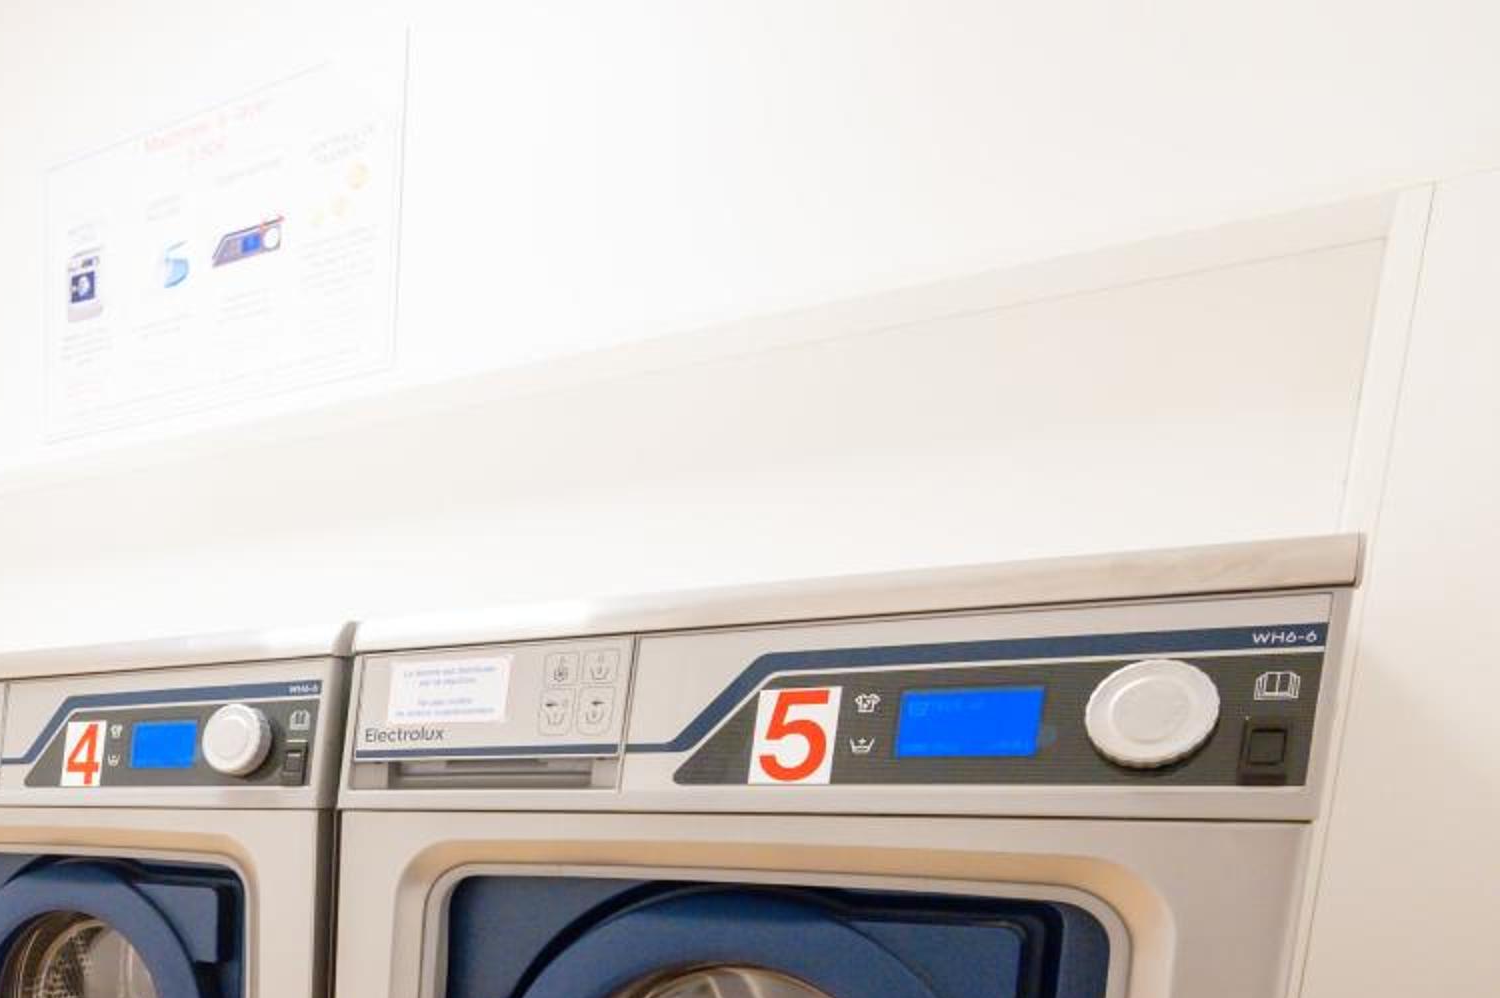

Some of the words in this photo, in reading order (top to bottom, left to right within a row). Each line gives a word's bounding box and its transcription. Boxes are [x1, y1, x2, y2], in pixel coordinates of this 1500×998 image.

[1252, 630, 1317, 644] WH6-6
[365, 725, 444, 742] Electrolux
[759, 689, 830, 781] 5
[67, 723, 100, 785] 4
